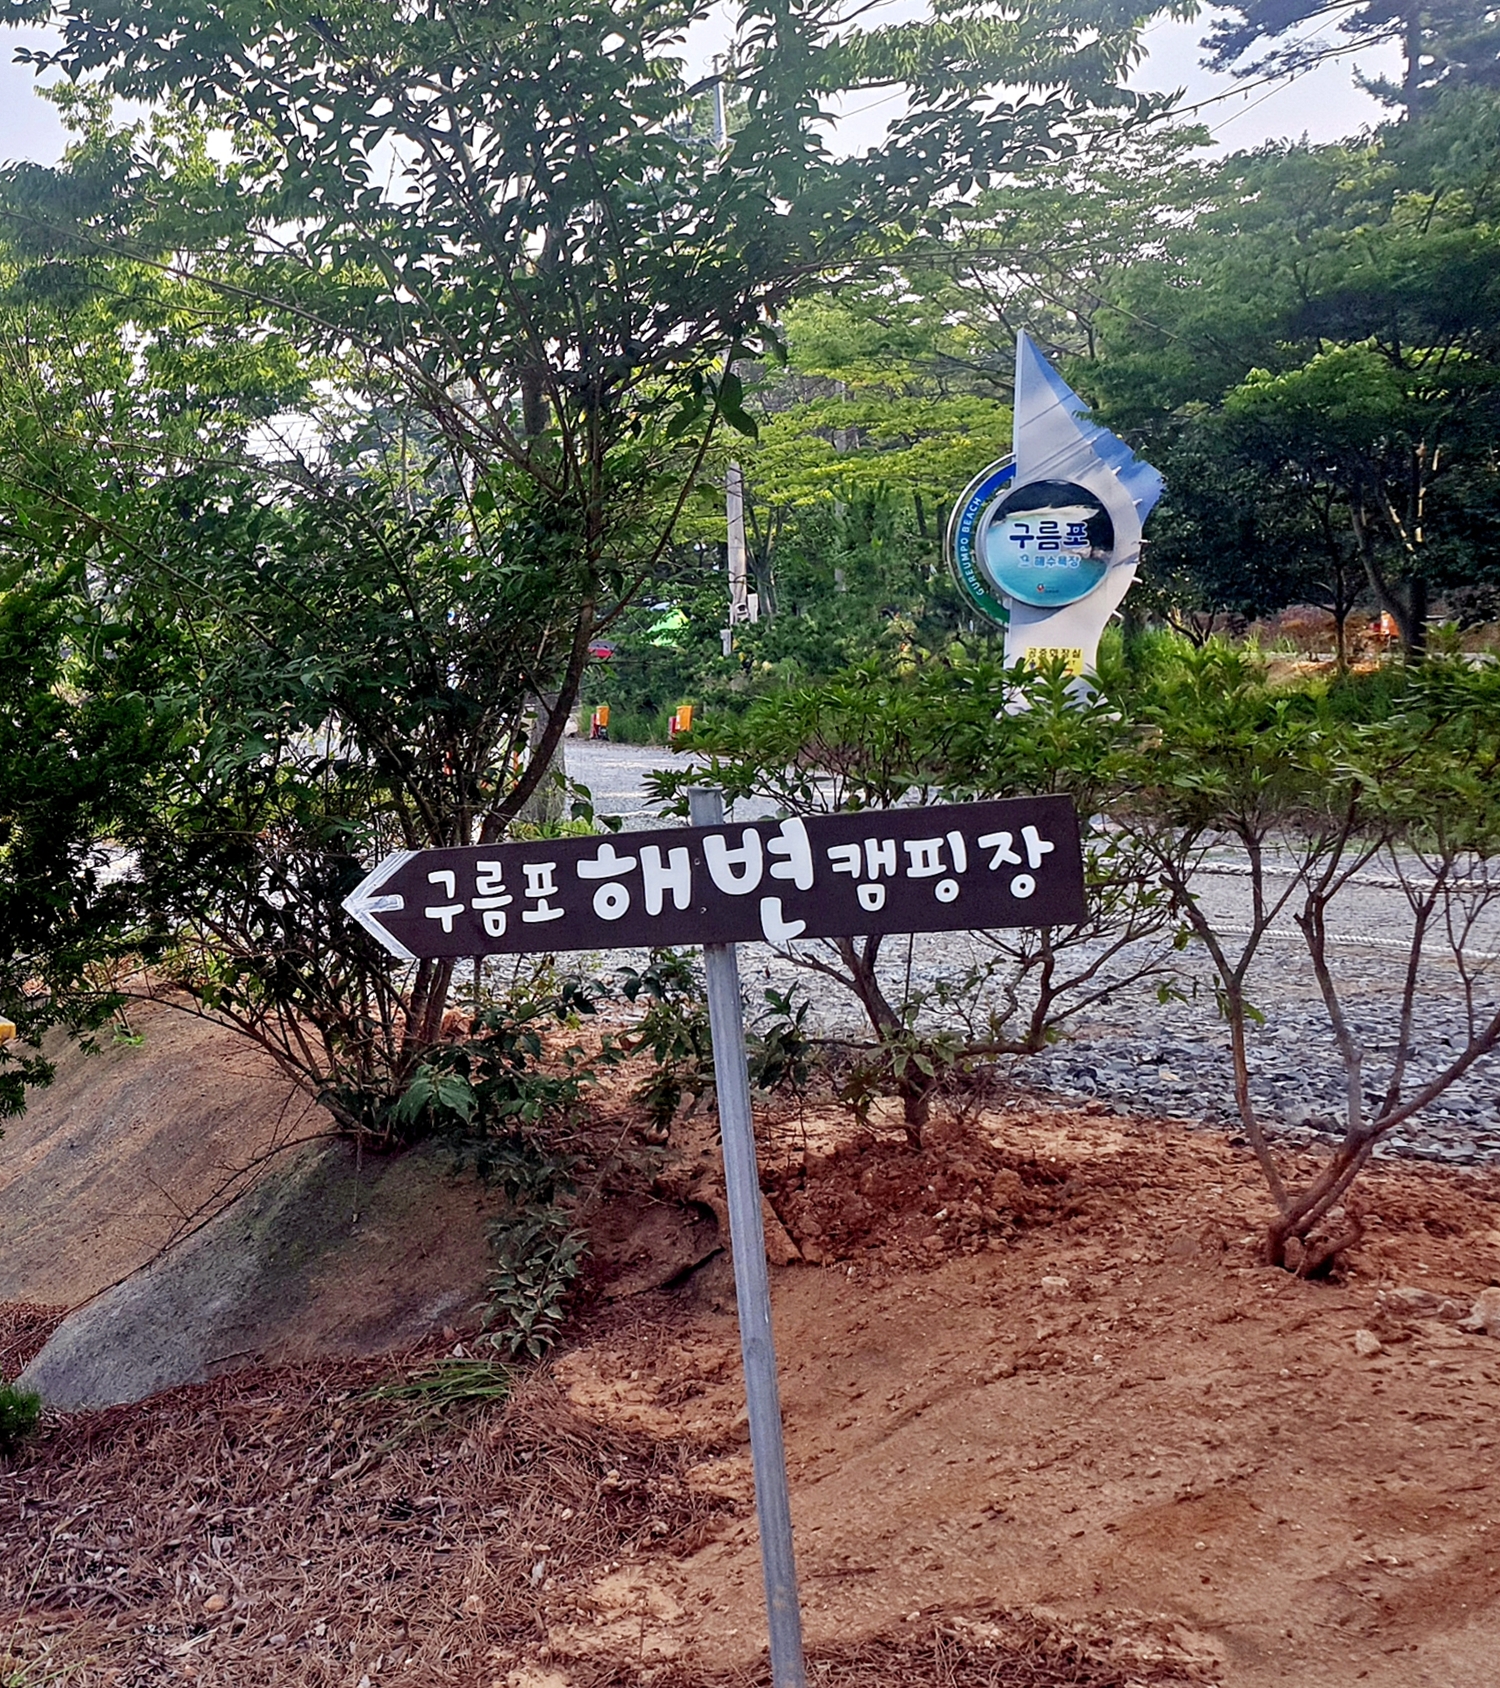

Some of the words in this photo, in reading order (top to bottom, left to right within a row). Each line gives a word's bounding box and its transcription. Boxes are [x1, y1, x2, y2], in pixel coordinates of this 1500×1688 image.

[961, 497, 982, 533] BEACH
[1008, 520, 1089, 551] 구름포
[960, 537, 985, 596] GUREUMPO
[1034, 555, 1081, 568] 해수욕장
[424, 860, 565, 938] 구름포
[576, 817, 814, 941] 해변
[827, 824, 1056, 912] 캠핑장
